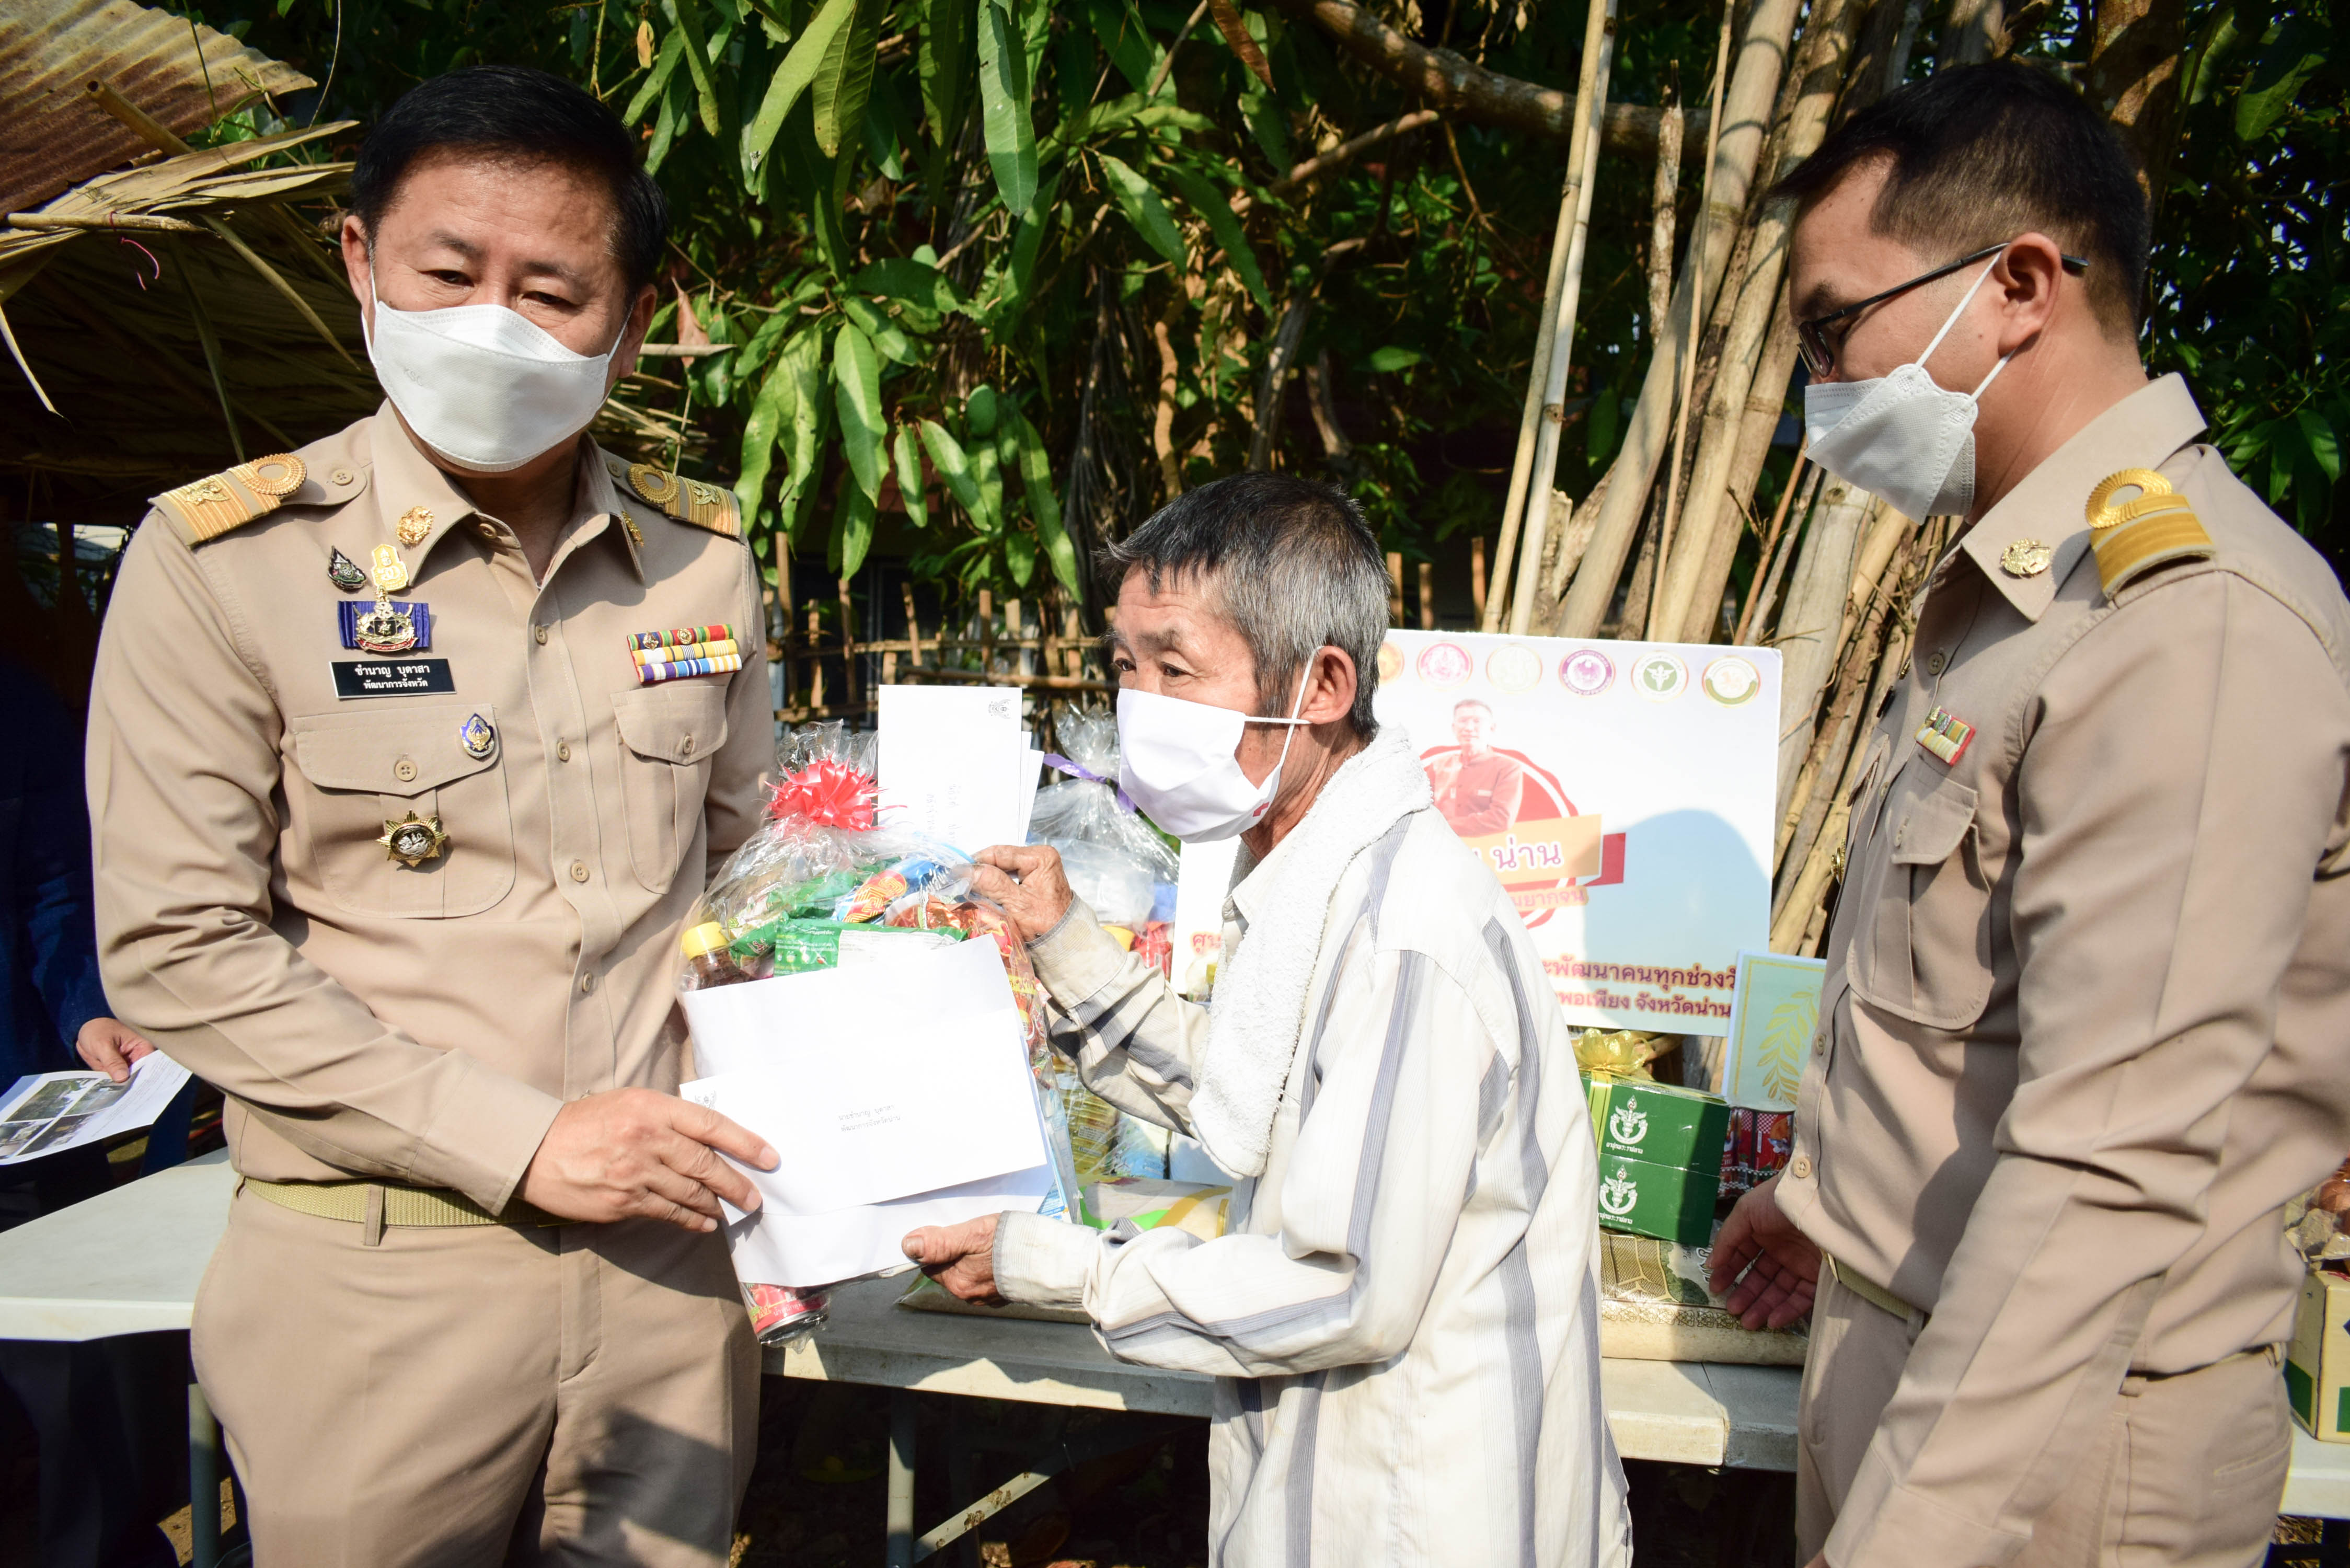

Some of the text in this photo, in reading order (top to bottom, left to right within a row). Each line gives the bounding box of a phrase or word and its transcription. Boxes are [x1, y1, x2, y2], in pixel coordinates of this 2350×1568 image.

[354, 664, 430, 678] ชำนาญ บุดาสา
[363, 677, 428, 689] พัฒนาการจังหวัด
[1493, 836, 1561, 869] น่าน
[1635, 993, 1731, 1017] จังหวัดน่าน
